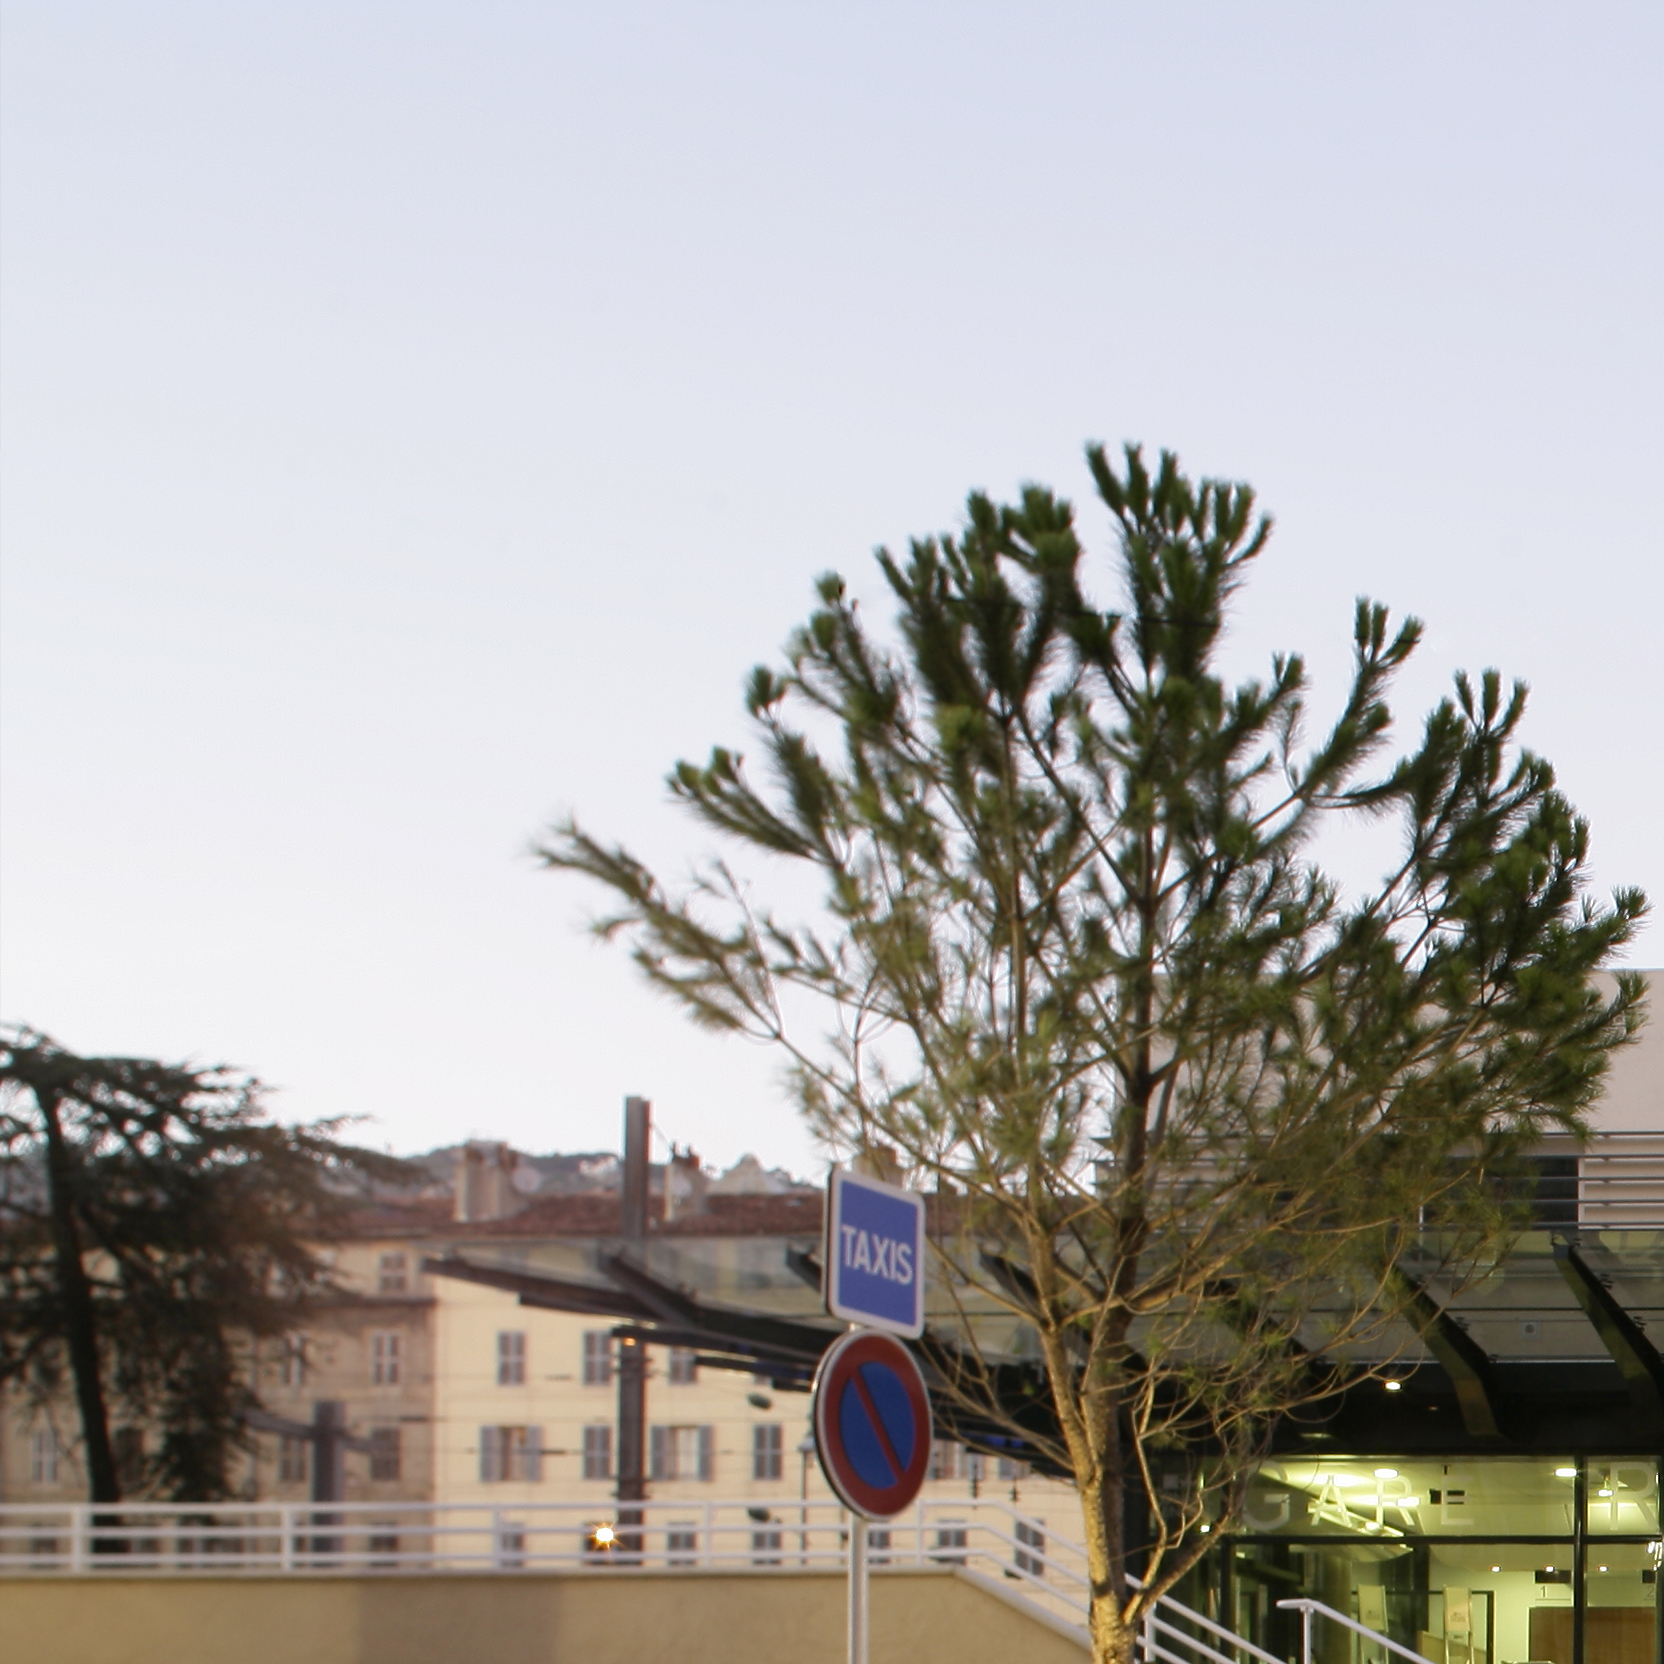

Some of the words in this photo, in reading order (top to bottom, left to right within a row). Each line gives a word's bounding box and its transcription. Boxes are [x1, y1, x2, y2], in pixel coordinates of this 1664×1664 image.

[841, 1223, 913, 1286] TAXIS
[1240, 1459, 1475, 1532] GARE
[1540, 1585, 1547, 1598] 1
[1646, 1585, 1655, 1598] 2
